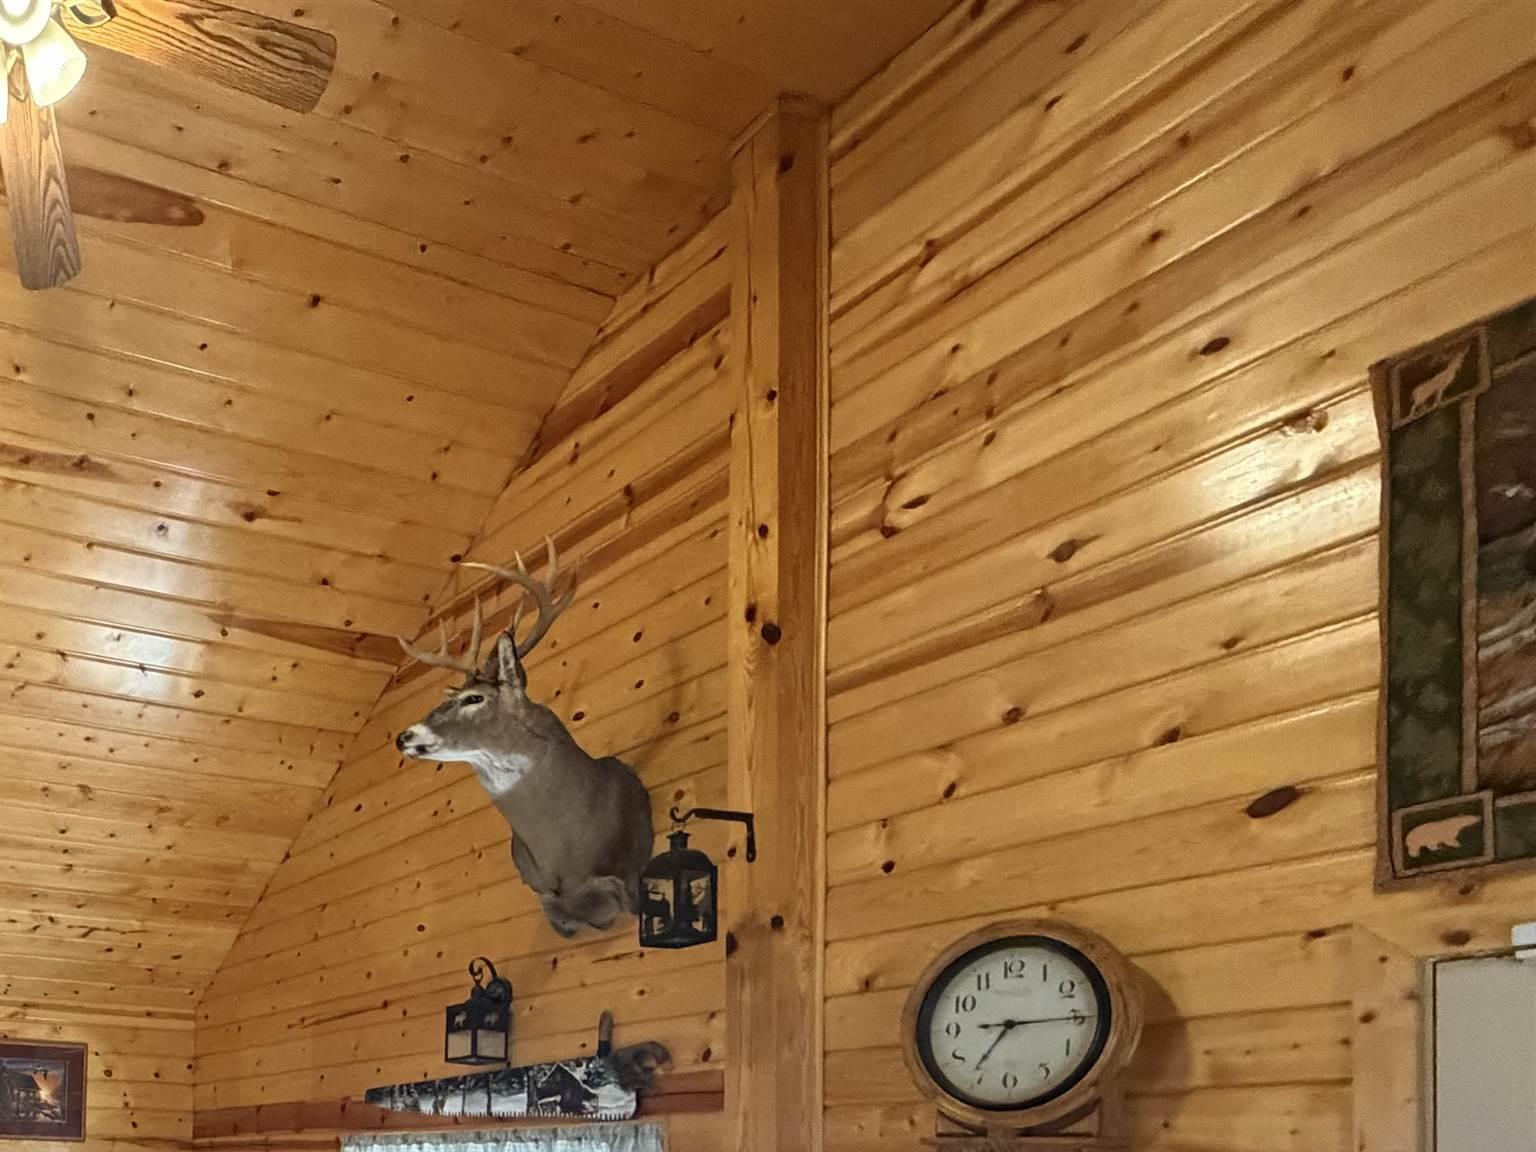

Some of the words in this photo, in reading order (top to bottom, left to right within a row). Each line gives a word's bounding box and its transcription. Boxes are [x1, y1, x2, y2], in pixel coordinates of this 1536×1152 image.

[1003, 959, 1025, 979] 12
[1042, 963, 1047, 982] 1
[977, 972, 990, 991] 11
[1059, 979, 1076, 998] 2
[955, 995, 977, 1014] 10
[945, 1022, 961, 1039] 9
